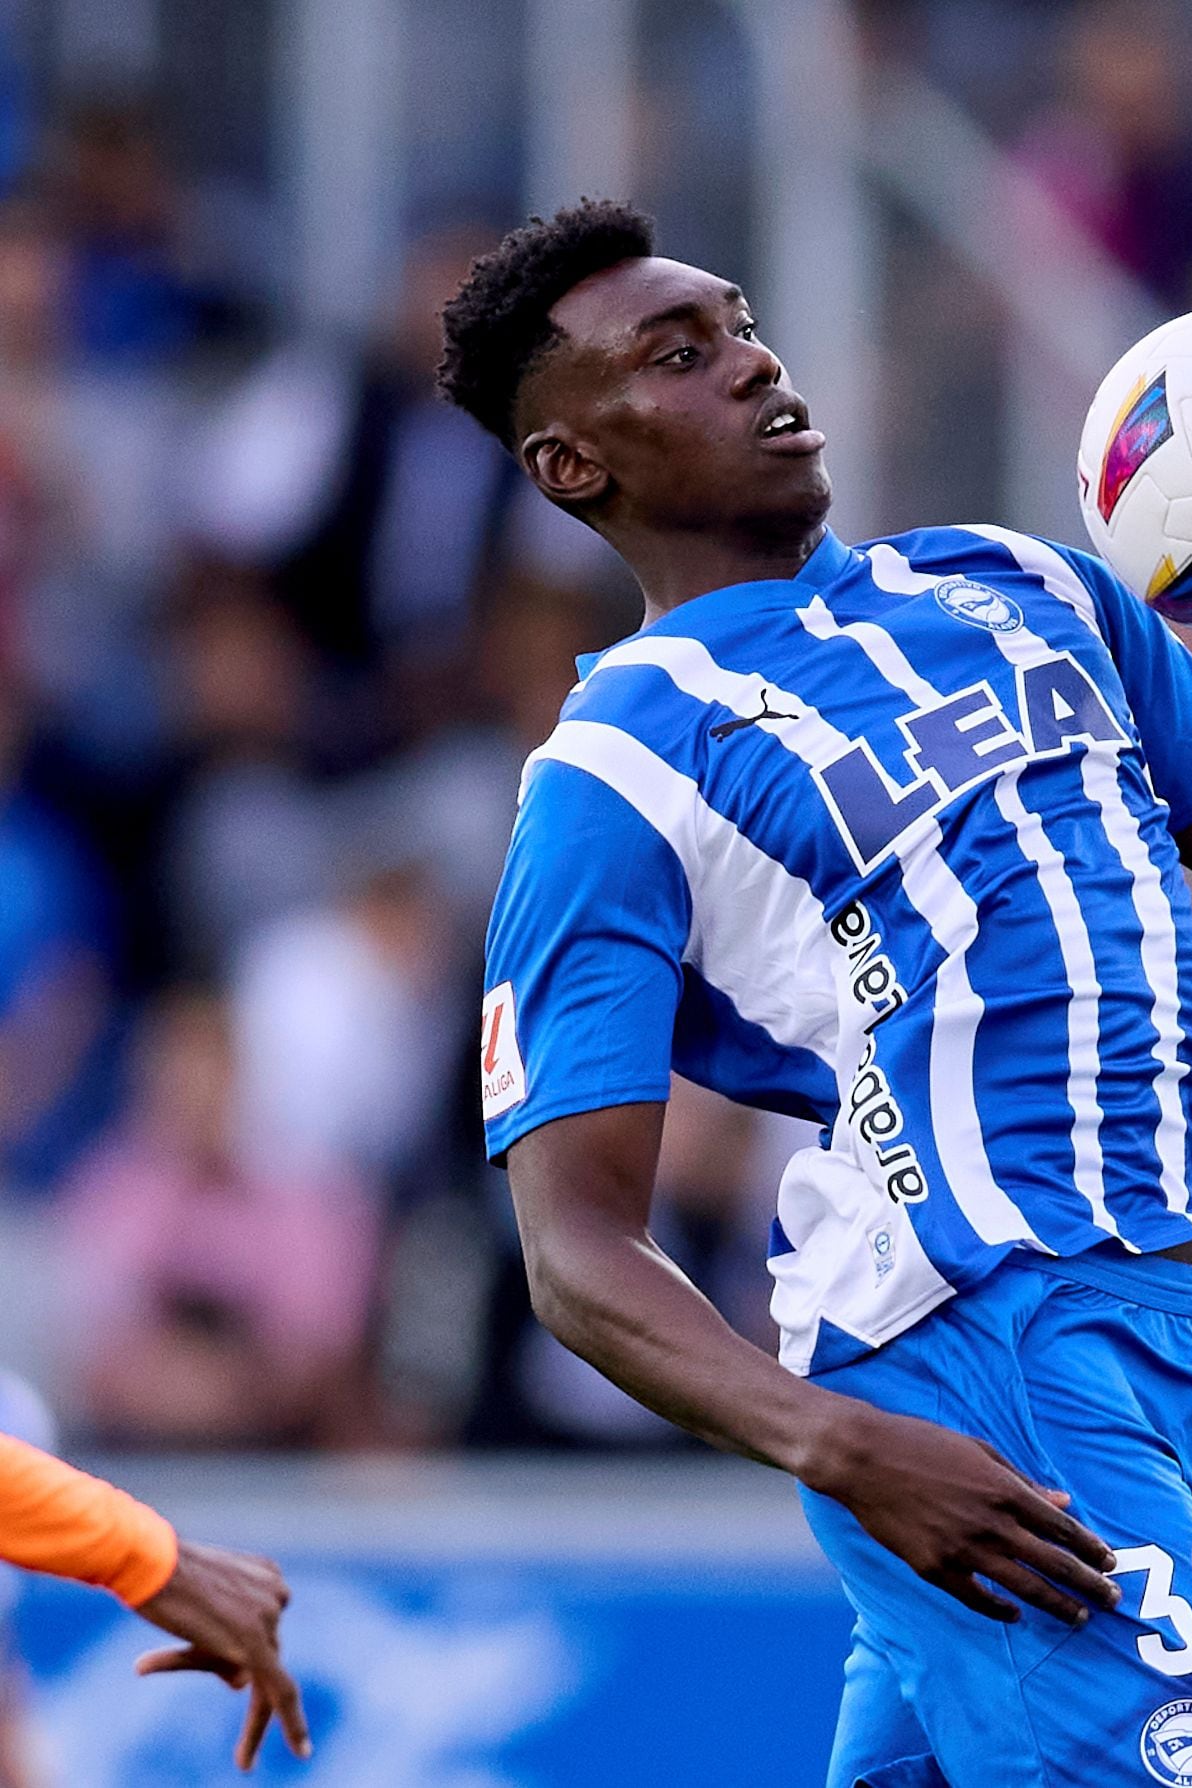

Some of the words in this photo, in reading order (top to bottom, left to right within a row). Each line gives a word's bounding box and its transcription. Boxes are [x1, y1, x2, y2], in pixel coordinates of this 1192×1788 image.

[811, 650, 1133, 877] LEA
[830, 900, 903, 1036] lava
[483, 1070, 515, 1099] ALIGA
[848, 1042, 924, 1204] arab
